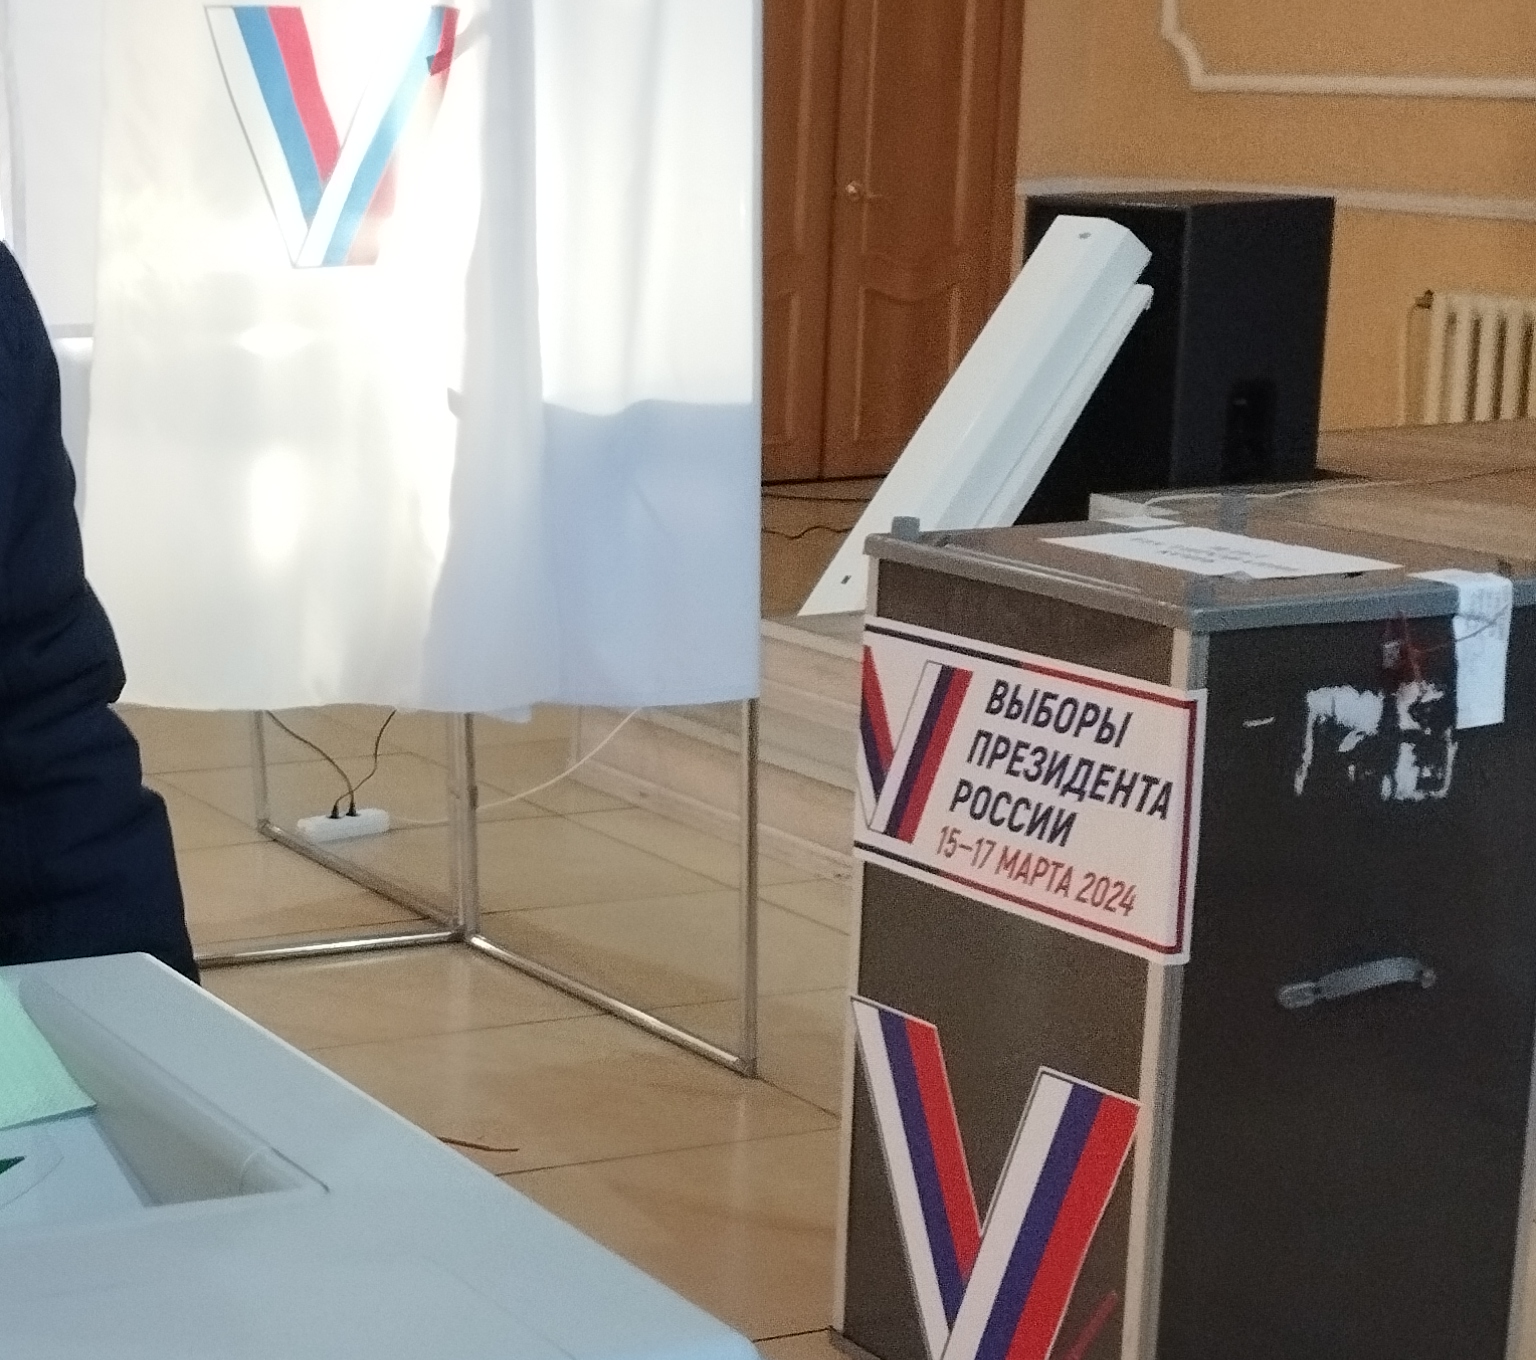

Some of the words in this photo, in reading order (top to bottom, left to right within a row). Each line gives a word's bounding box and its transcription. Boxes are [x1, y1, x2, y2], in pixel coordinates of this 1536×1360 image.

[984, 678, 1134, 748] ВЫБОРЫ
[966, 728, 1174, 820] ПРЕЗИДЕНТА
[948, 778, 1078, 847] РОССИИ
[994, 845, 1075, 898] МАРТА
[1075, 871, 1137, 917] 2024
